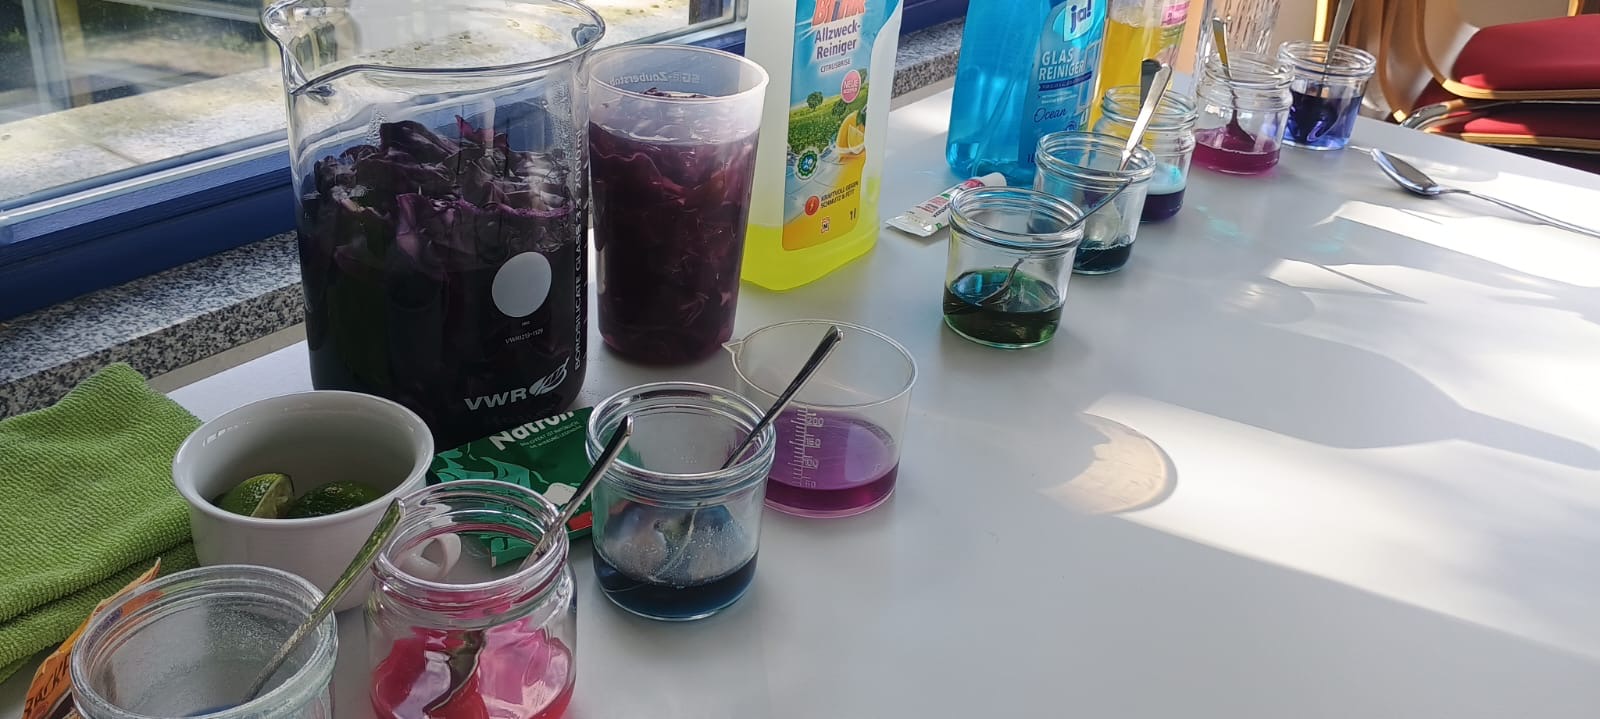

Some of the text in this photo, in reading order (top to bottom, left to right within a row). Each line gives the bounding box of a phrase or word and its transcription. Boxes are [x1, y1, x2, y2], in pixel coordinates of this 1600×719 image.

[814, 19, 861, 44] Allzweck-
[816, 38, 857, 60] Reiniger
[1041, 48, 1074, 65] GLAS
[1038, 60, 1084, 81] REINIGER
[1033, 107, 1067, 123] Ocean
[574, 273, 582, 370] BOROSILICATE
[463, 387, 527, 411] VWR
[806, 416, 824, 428] 200
